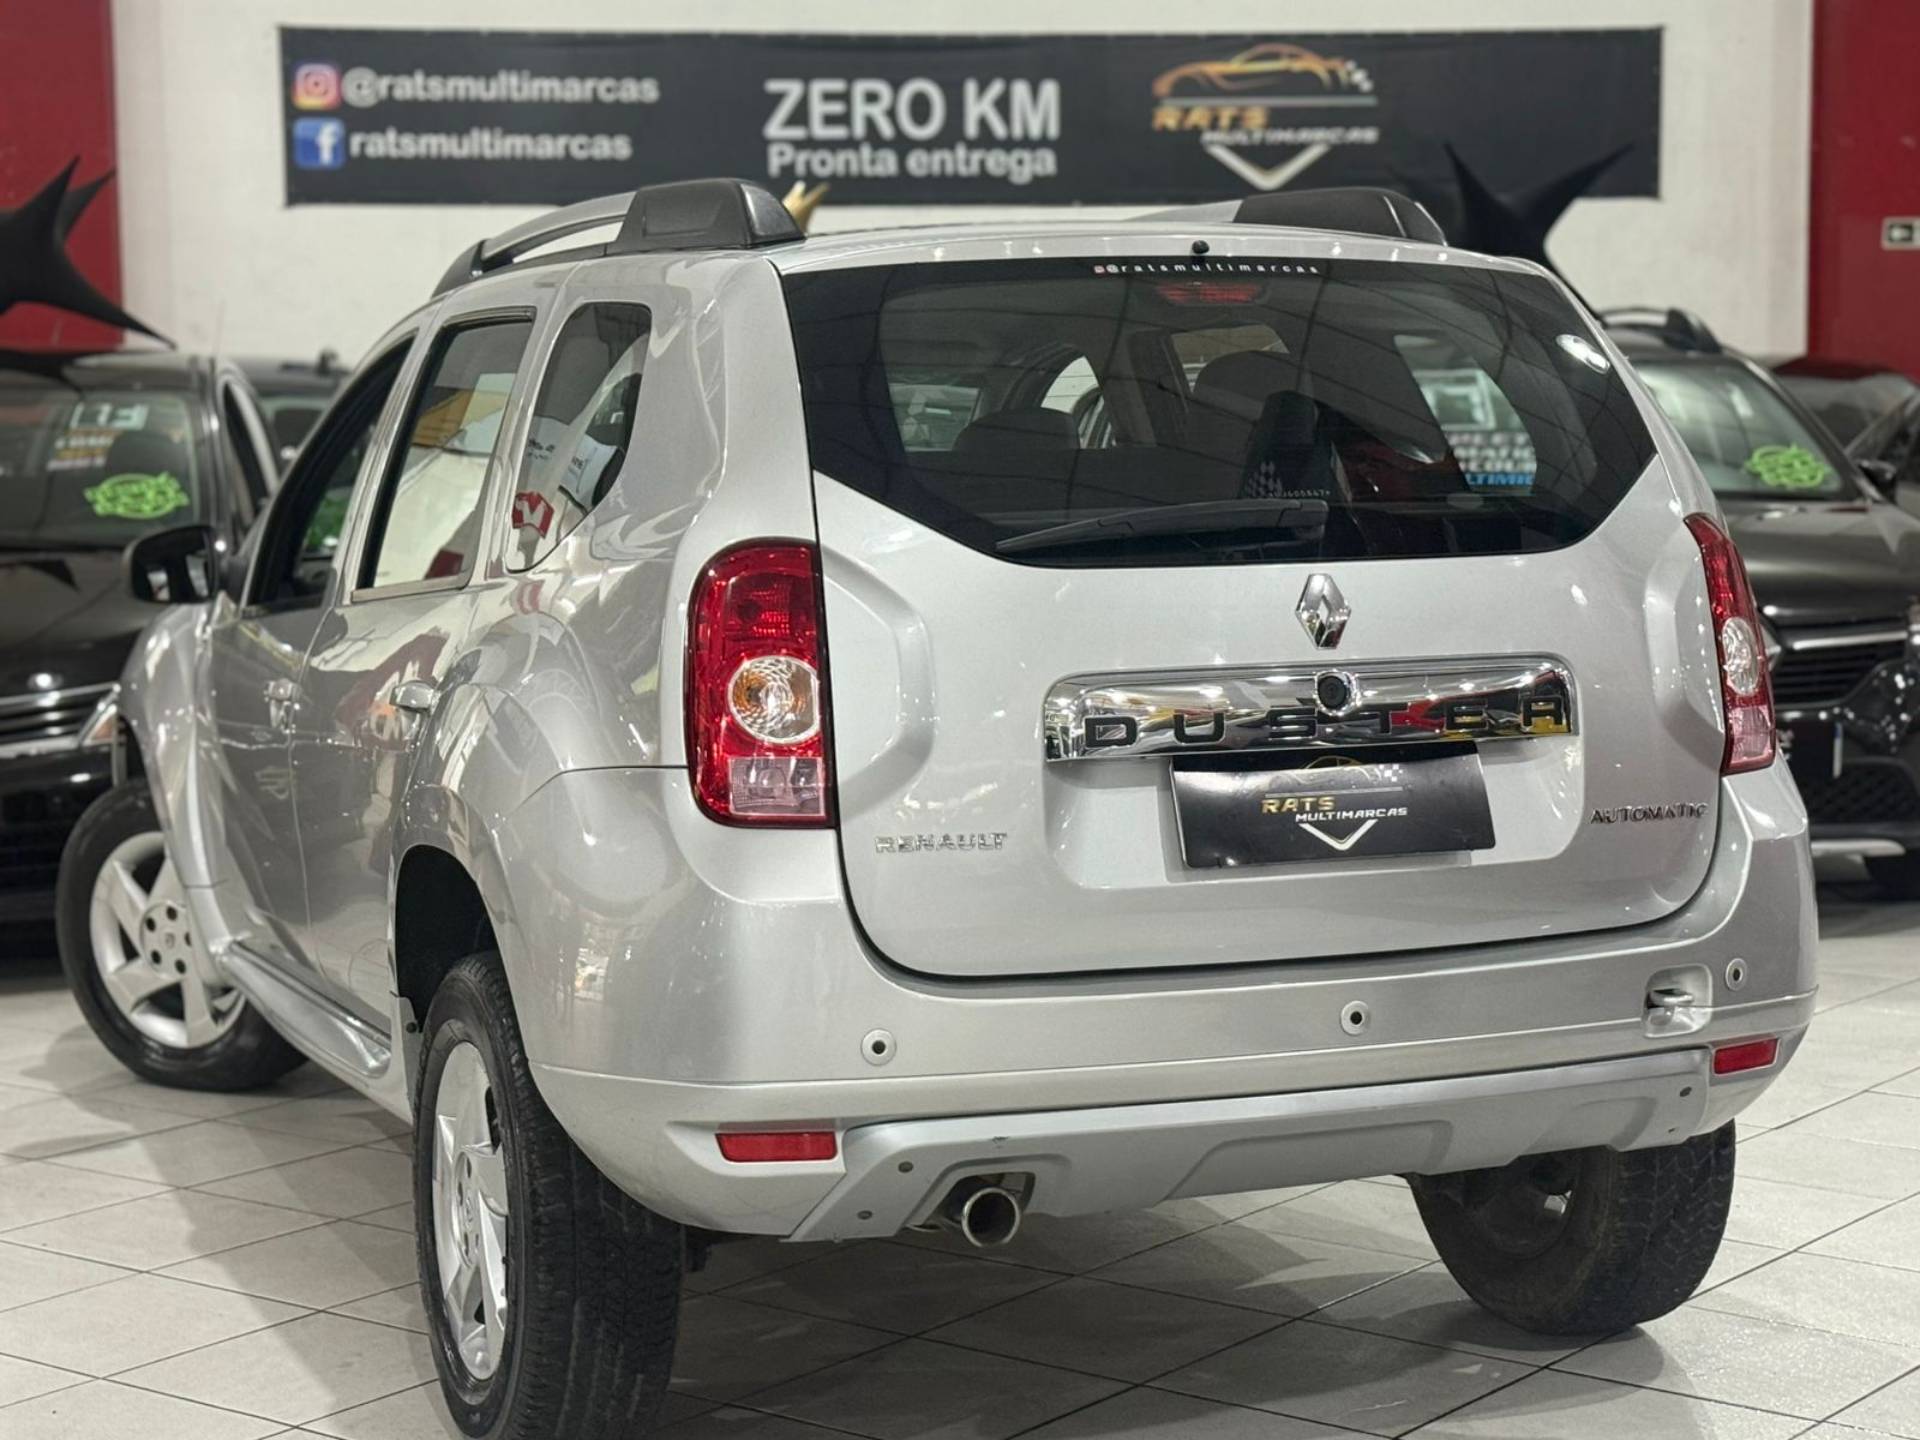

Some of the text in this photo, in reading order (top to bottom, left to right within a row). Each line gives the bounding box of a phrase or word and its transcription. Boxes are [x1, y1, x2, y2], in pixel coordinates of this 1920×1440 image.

[342, 67, 660, 108] @ratsmultimarcas
[762, 76, 1060, 141] ZERO KM
[1153, 106, 1269, 131] RATS
[350, 126, 633, 160] ratsmultimarcas
[767, 142, 1057, 185] Pronta entrega
[1084, 696, 1563, 748] DUSTER
[1261, 796, 1335, 814] RATS
[1295, 807, 1408, 823] MULTIMARCAS
[1590, 803, 1708, 824] AUTOMATIC
[875, 832, 1007, 853] RENAULT
